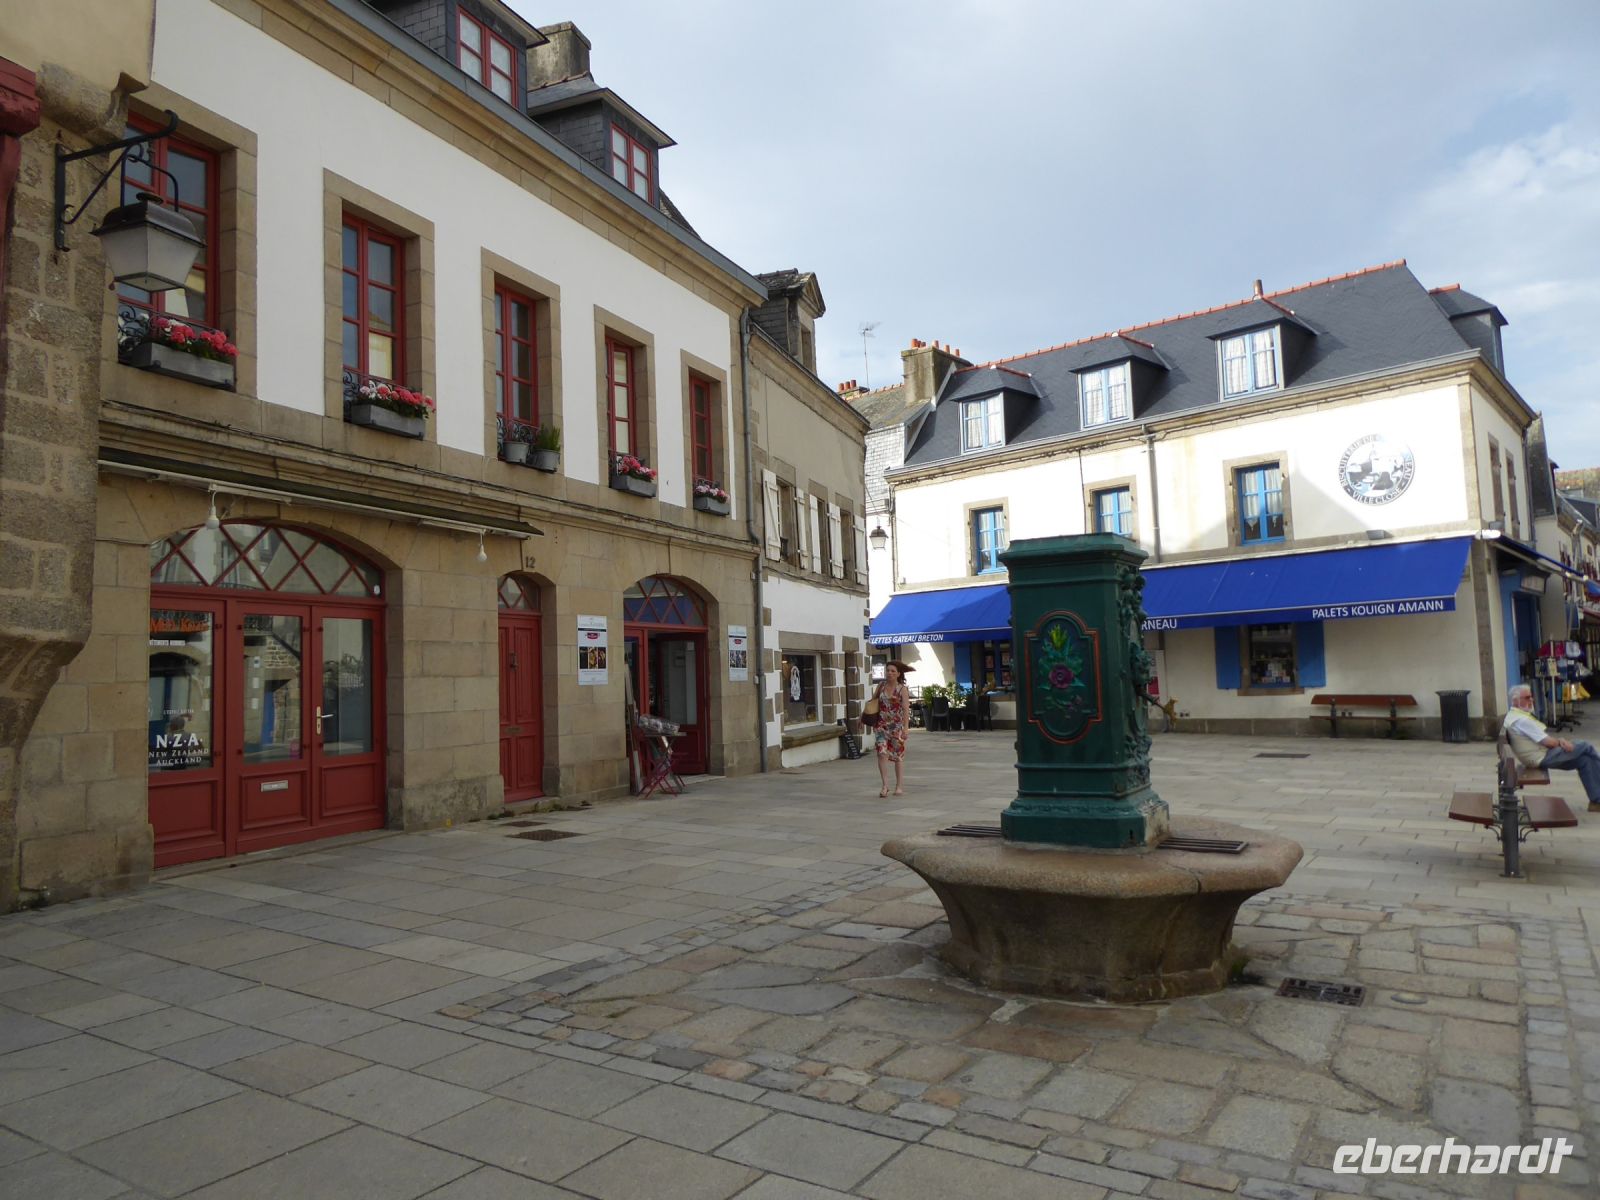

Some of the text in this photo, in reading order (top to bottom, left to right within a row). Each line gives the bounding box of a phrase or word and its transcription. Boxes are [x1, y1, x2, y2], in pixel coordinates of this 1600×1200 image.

[525, 556, 536, 568] 12
[1312, 600, 1444, 619] PALETS KOUIGN AMANN
[1141, 618, 1177, 630] RNEAU
[871, 633, 944, 644] LETTES GATEAU BRETON
[172, 748, 209, 757] ZEALAND
[157, 757, 202, 766] AUCKLAND
